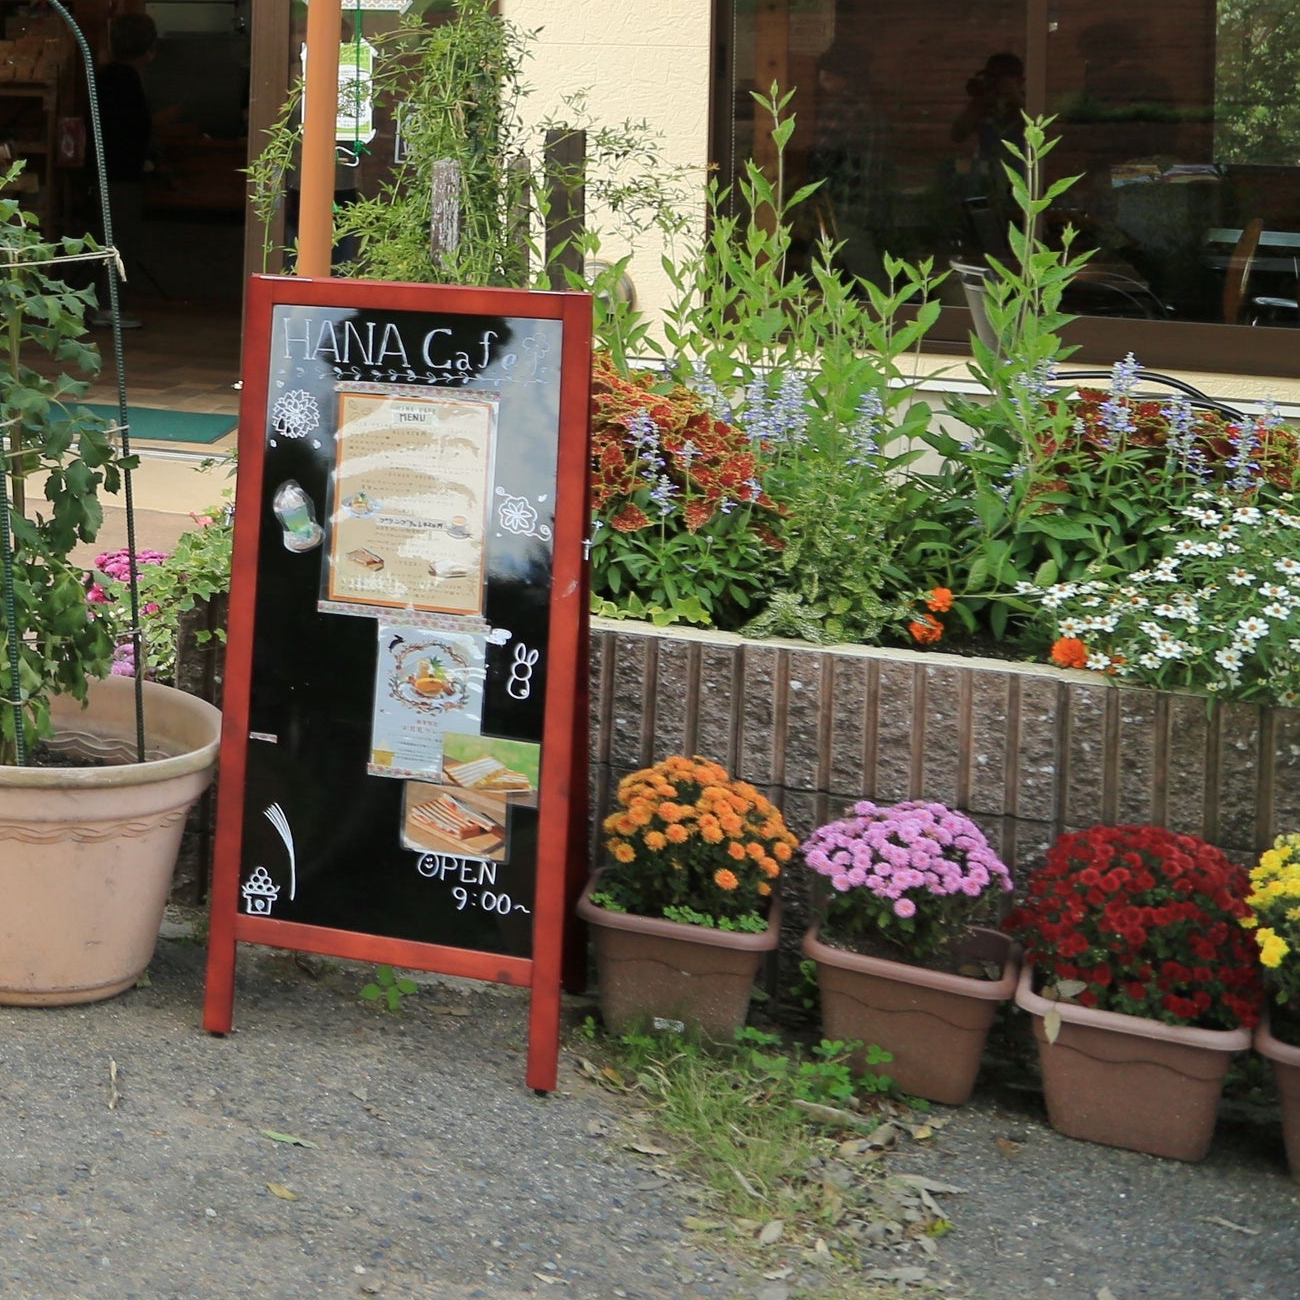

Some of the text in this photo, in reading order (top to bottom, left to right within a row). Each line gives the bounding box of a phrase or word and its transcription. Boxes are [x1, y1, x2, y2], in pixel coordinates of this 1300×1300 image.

[282, 317, 518, 371] HANA Cafe
[399, 412, 426, 423] MENU
[417, 852, 497, 885] OPEN
